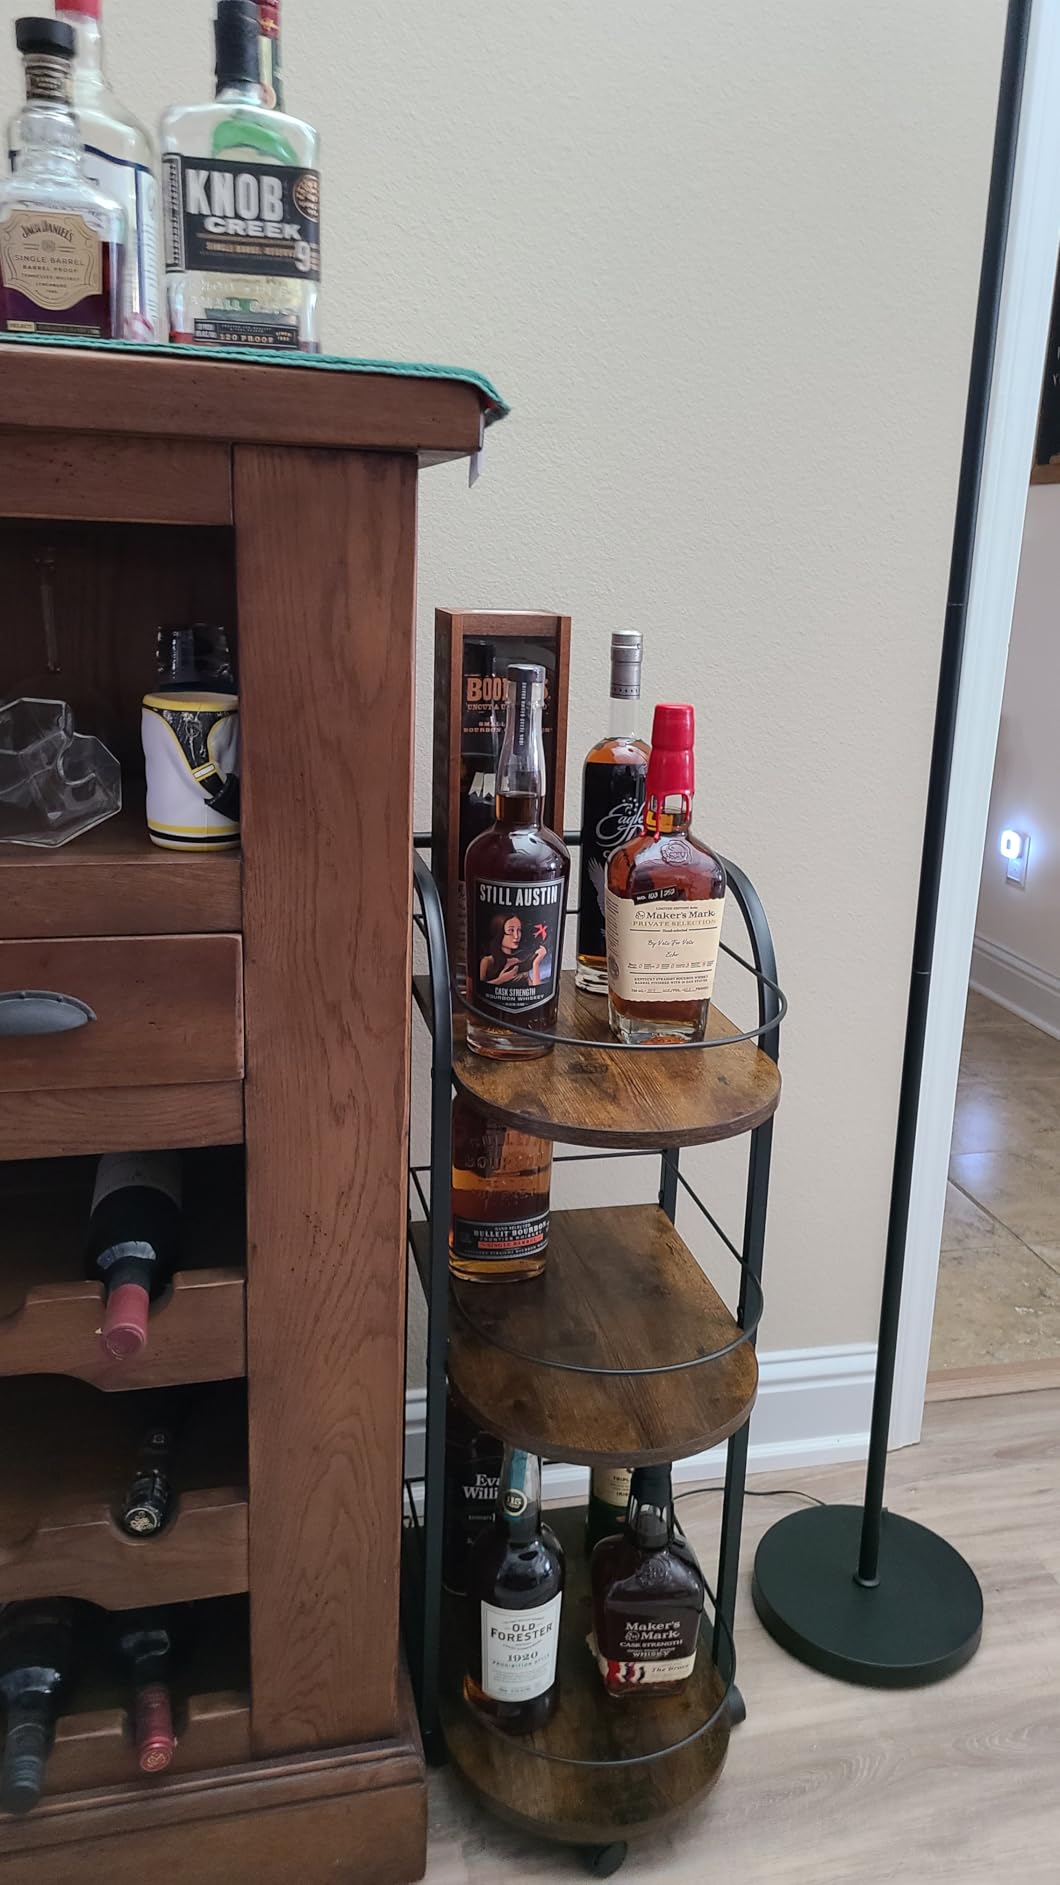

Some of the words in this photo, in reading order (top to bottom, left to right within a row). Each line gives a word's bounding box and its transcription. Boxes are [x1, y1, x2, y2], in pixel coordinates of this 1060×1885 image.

[184, 168, 284, 222] KNOB
[203, 217, 302, 240] CREEK
[15, 254, 47, 264] SINGLE
[50, 256, 84, 266] BARREL
[294, 240, 311, 273] 9
[240, 335, 274, 343] PROOF
[479, 884, 513, 906] STILL
[514, 885, 558, 907] AUSTIN
[646, 911, 687, 920] Maker's
[688, 910, 716, 919] Mark
[485, 993, 516, 1001] BOURBON
[517, 994, 545, 1002] WHISKEY
[494, 987, 509, 996] CASK
[509, 987, 536, 997] STRENGTH
[473, 1230, 509, 1238] BULLEIT
[511, 1221, 547, 1237] BOURBON
[475, 1473, 500, 1486] Ev
[463, 1486, 498, 1500] Willi
[512, 1622, 536, 1632] OLD
[625, 1621, 681, 1631] Maker's
[490, 1623, 553, 1642] FORESTER
[641, 1630, 681, 1640] Mark
[642, 1639, 684, 1648] STRENGTH
[507, 1652, 538, 1662] 1920
